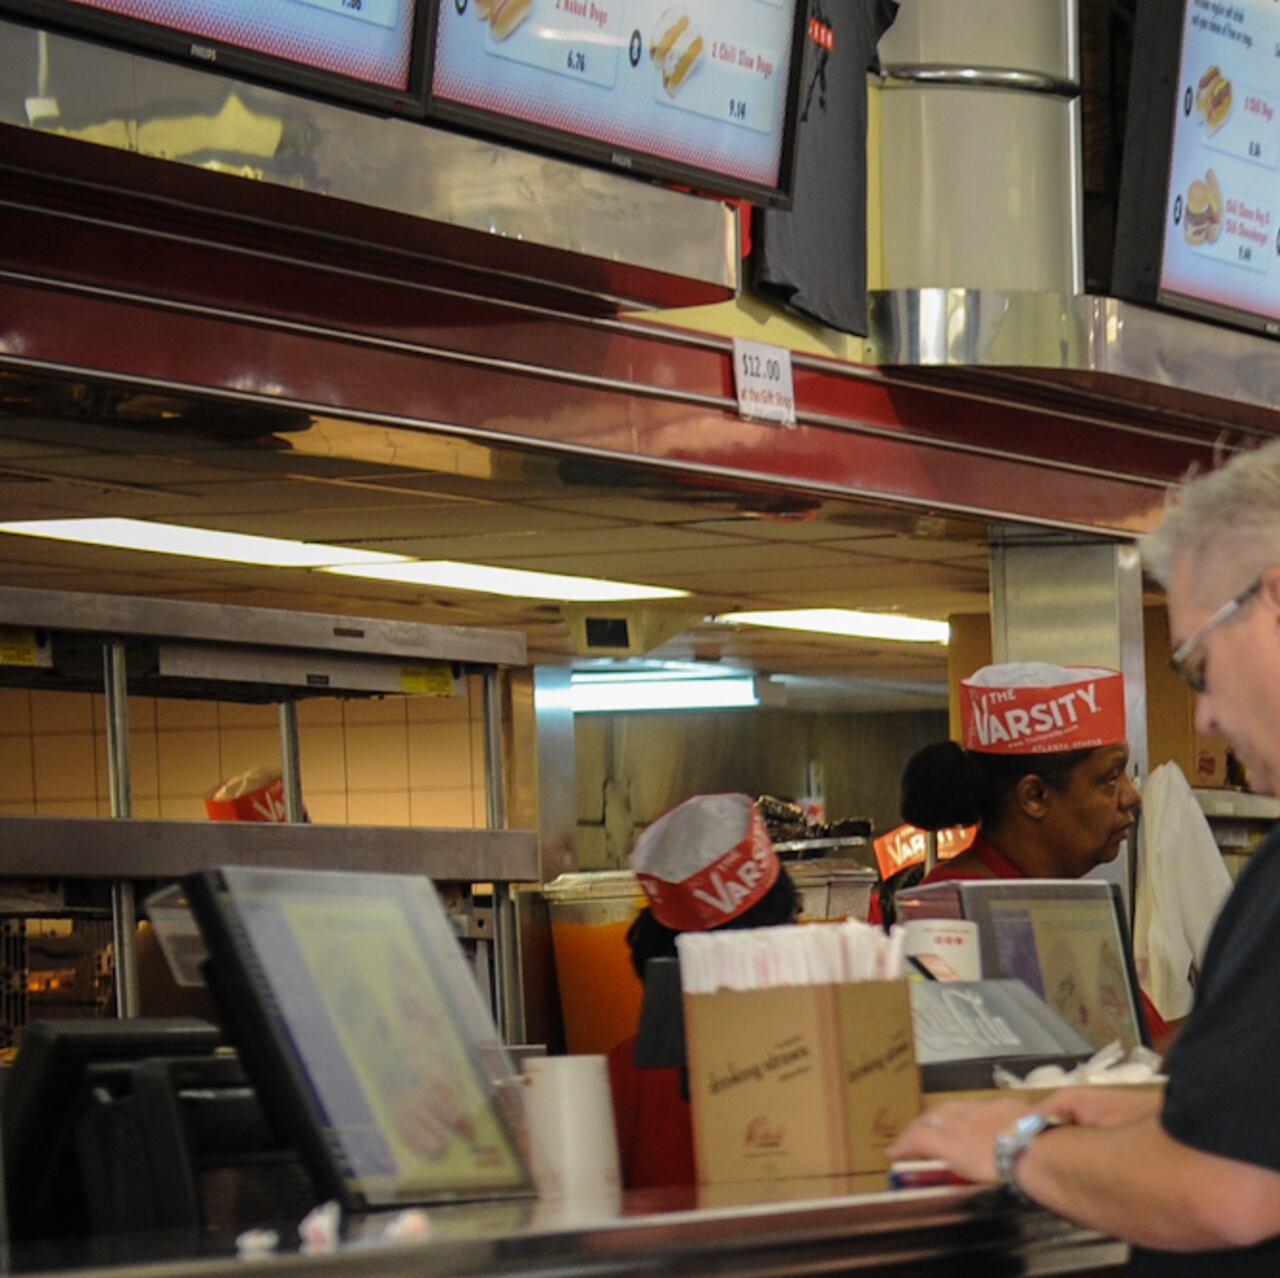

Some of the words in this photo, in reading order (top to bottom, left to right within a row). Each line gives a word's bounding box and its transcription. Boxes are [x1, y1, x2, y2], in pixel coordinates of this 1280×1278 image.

[590, 3, 609, 28] Dogs
[719, 43, 736, 62] Chili
[756, 55, 774, 79] Dogs
[742, 353, 781, 382] $12.00
[989, 688, 1017, 705] THE
[972, 682, 1099, 747] VARSITY
